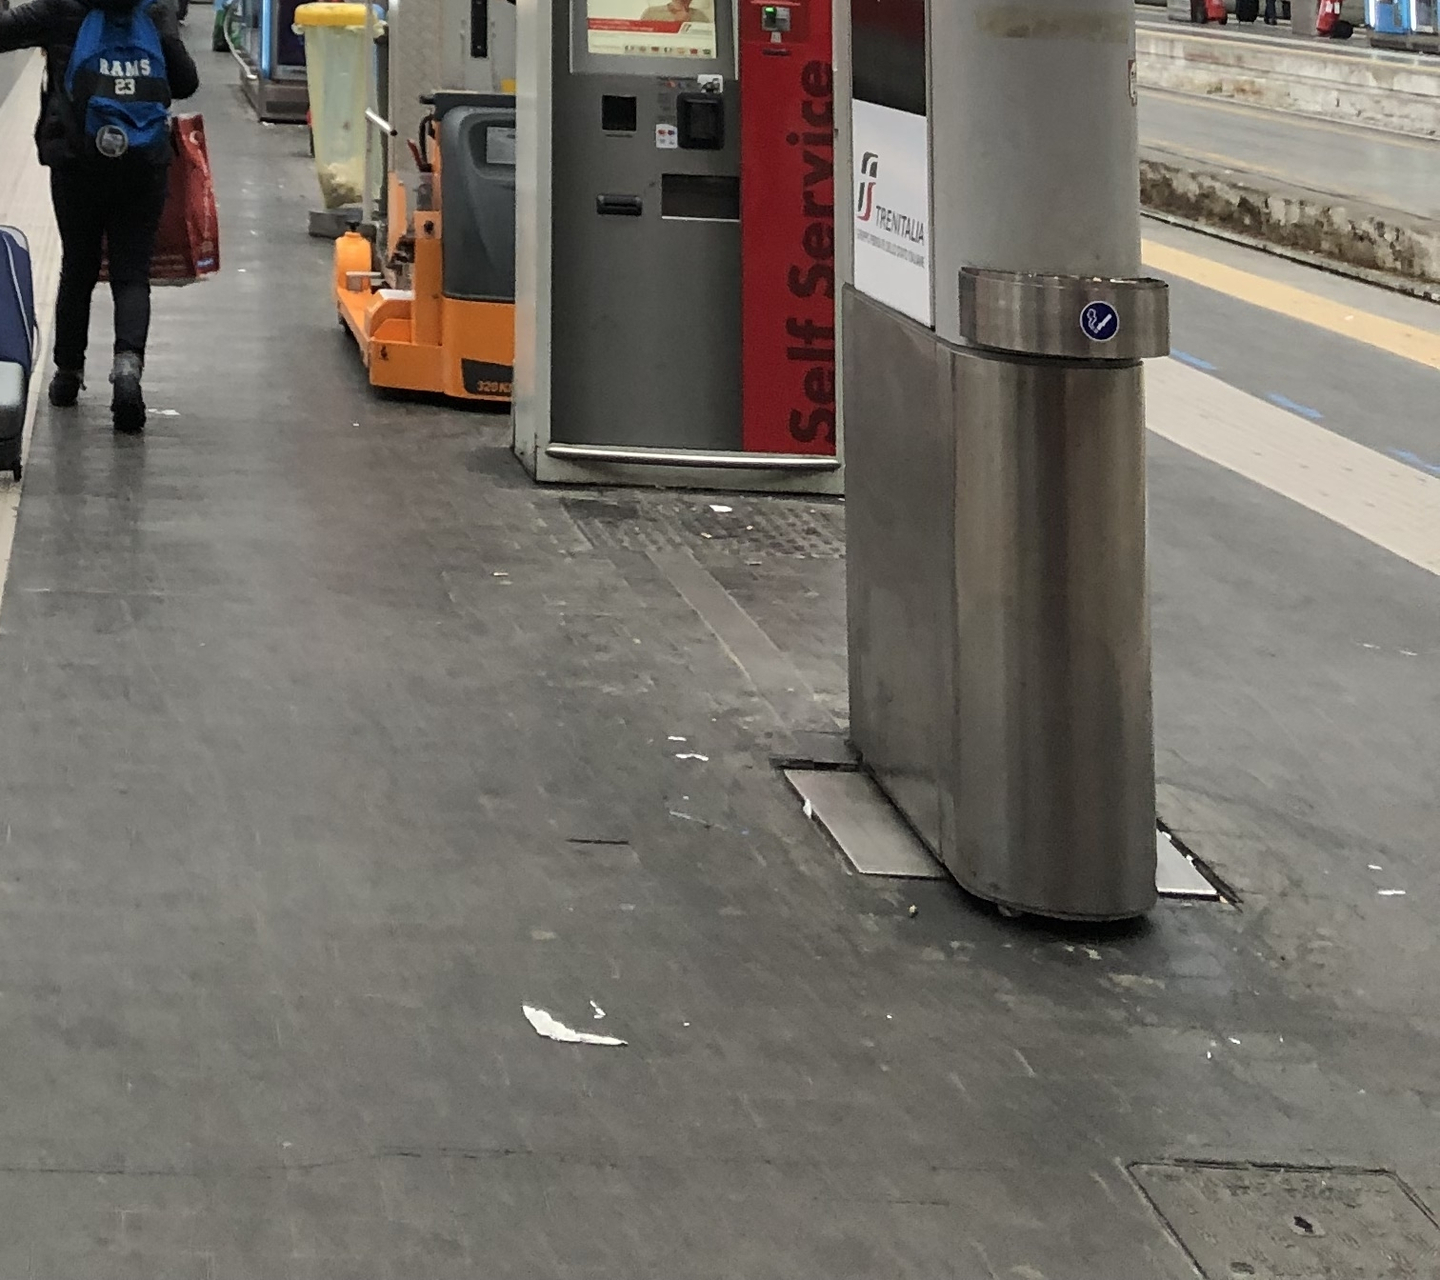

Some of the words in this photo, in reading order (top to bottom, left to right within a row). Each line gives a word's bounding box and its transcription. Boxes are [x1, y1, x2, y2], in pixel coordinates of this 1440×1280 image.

[99, 57, 151, 77] RAMS
[114, 78, 136, 95] 23
[785, 60, 835, 299] Service
[875, 205, 925, 247] TRENITALIA
[785, 317, 836, 444] Self
